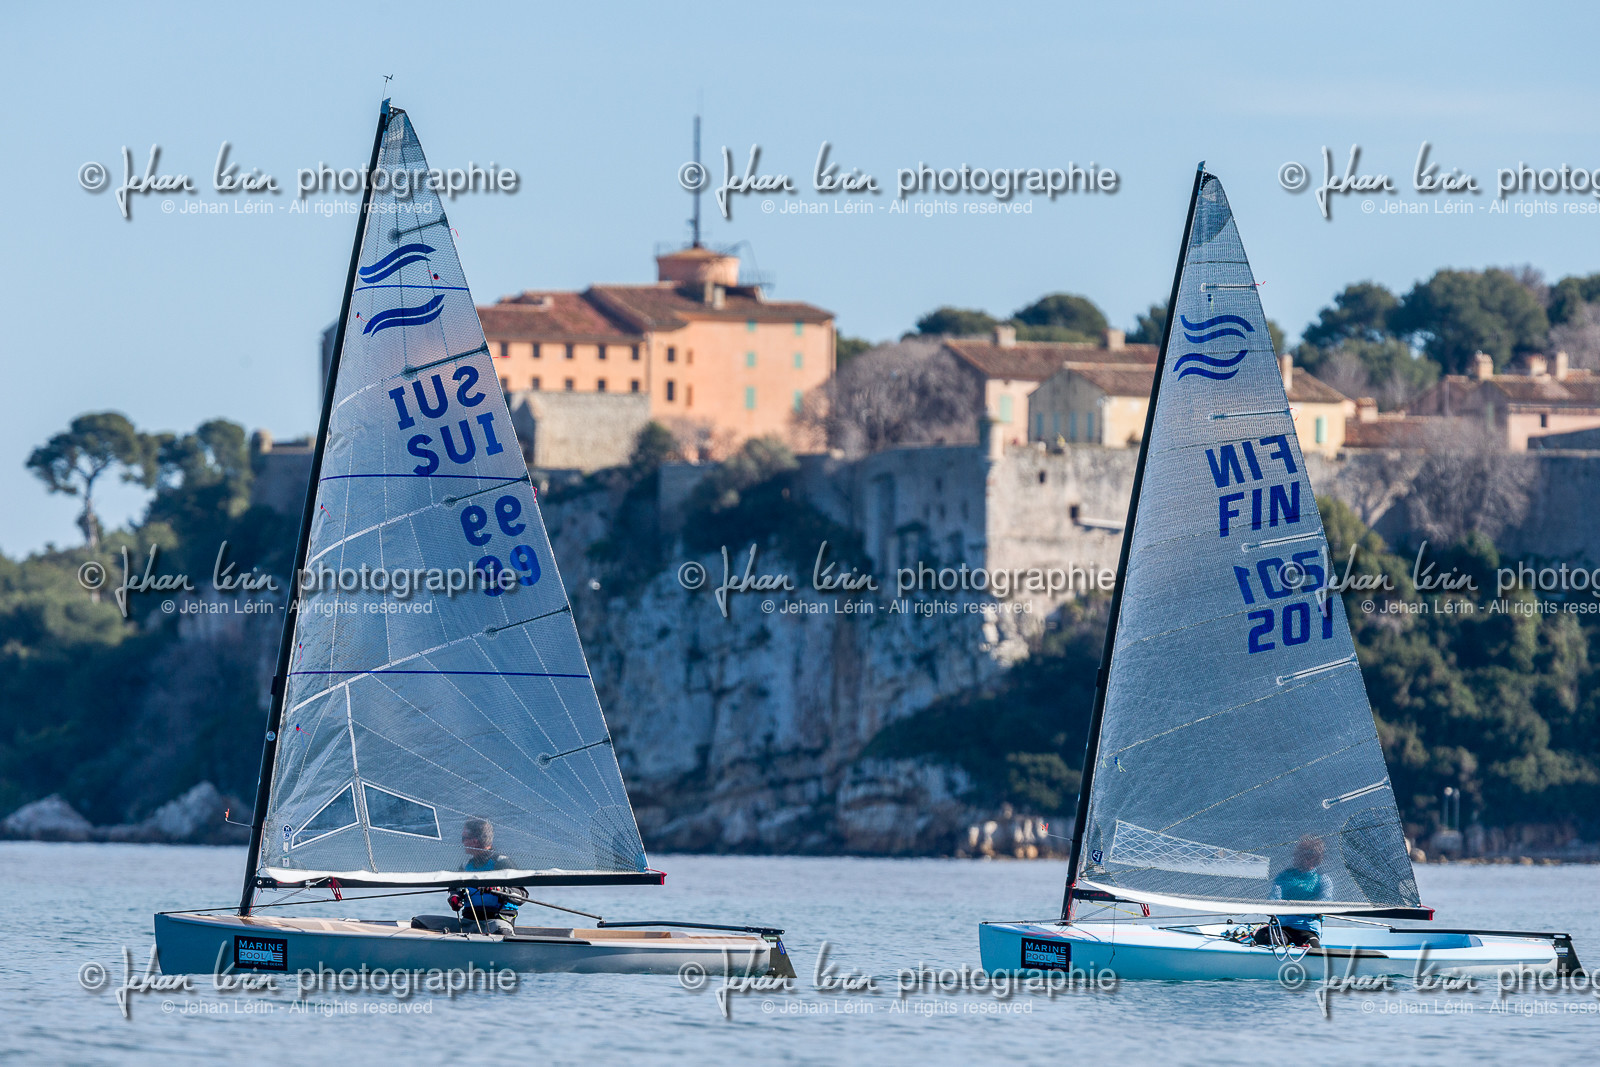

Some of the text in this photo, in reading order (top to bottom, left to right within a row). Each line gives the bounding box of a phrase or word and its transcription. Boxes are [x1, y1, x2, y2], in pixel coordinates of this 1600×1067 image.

[407, 412, 504, 476] SUI
[1218, 481, 1300, 537] FIN
[475, 544, 541, 597] 99
[1247, 596, 1333, 654] 201
[239, 939, 284, 952] MARINE
[240, 951, 265, 960] POOL
[1025, 942, 1066, 953] MARINE
[1026, 952, 1050, 961] POOL
